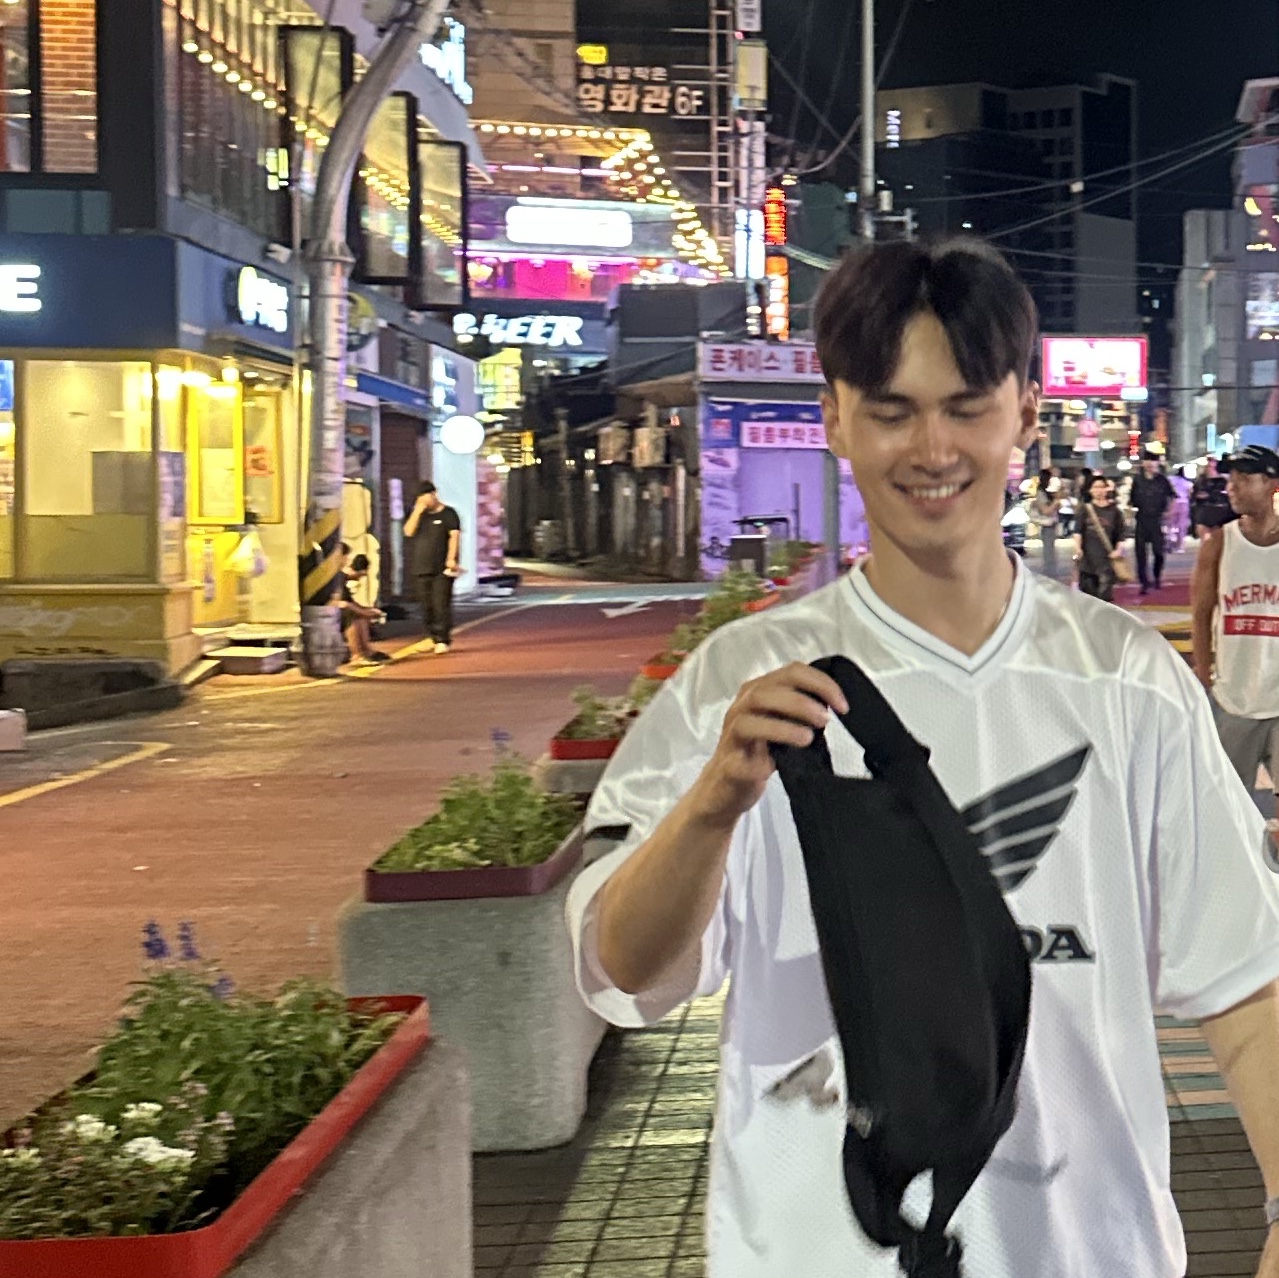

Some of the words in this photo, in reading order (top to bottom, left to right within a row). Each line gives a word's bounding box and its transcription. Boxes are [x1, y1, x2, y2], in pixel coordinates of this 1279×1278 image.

[578, 83, 671, 113] 영화관
[674, 86, 703, 114] 6F
[1233, 618, 1256, 631] OFF
